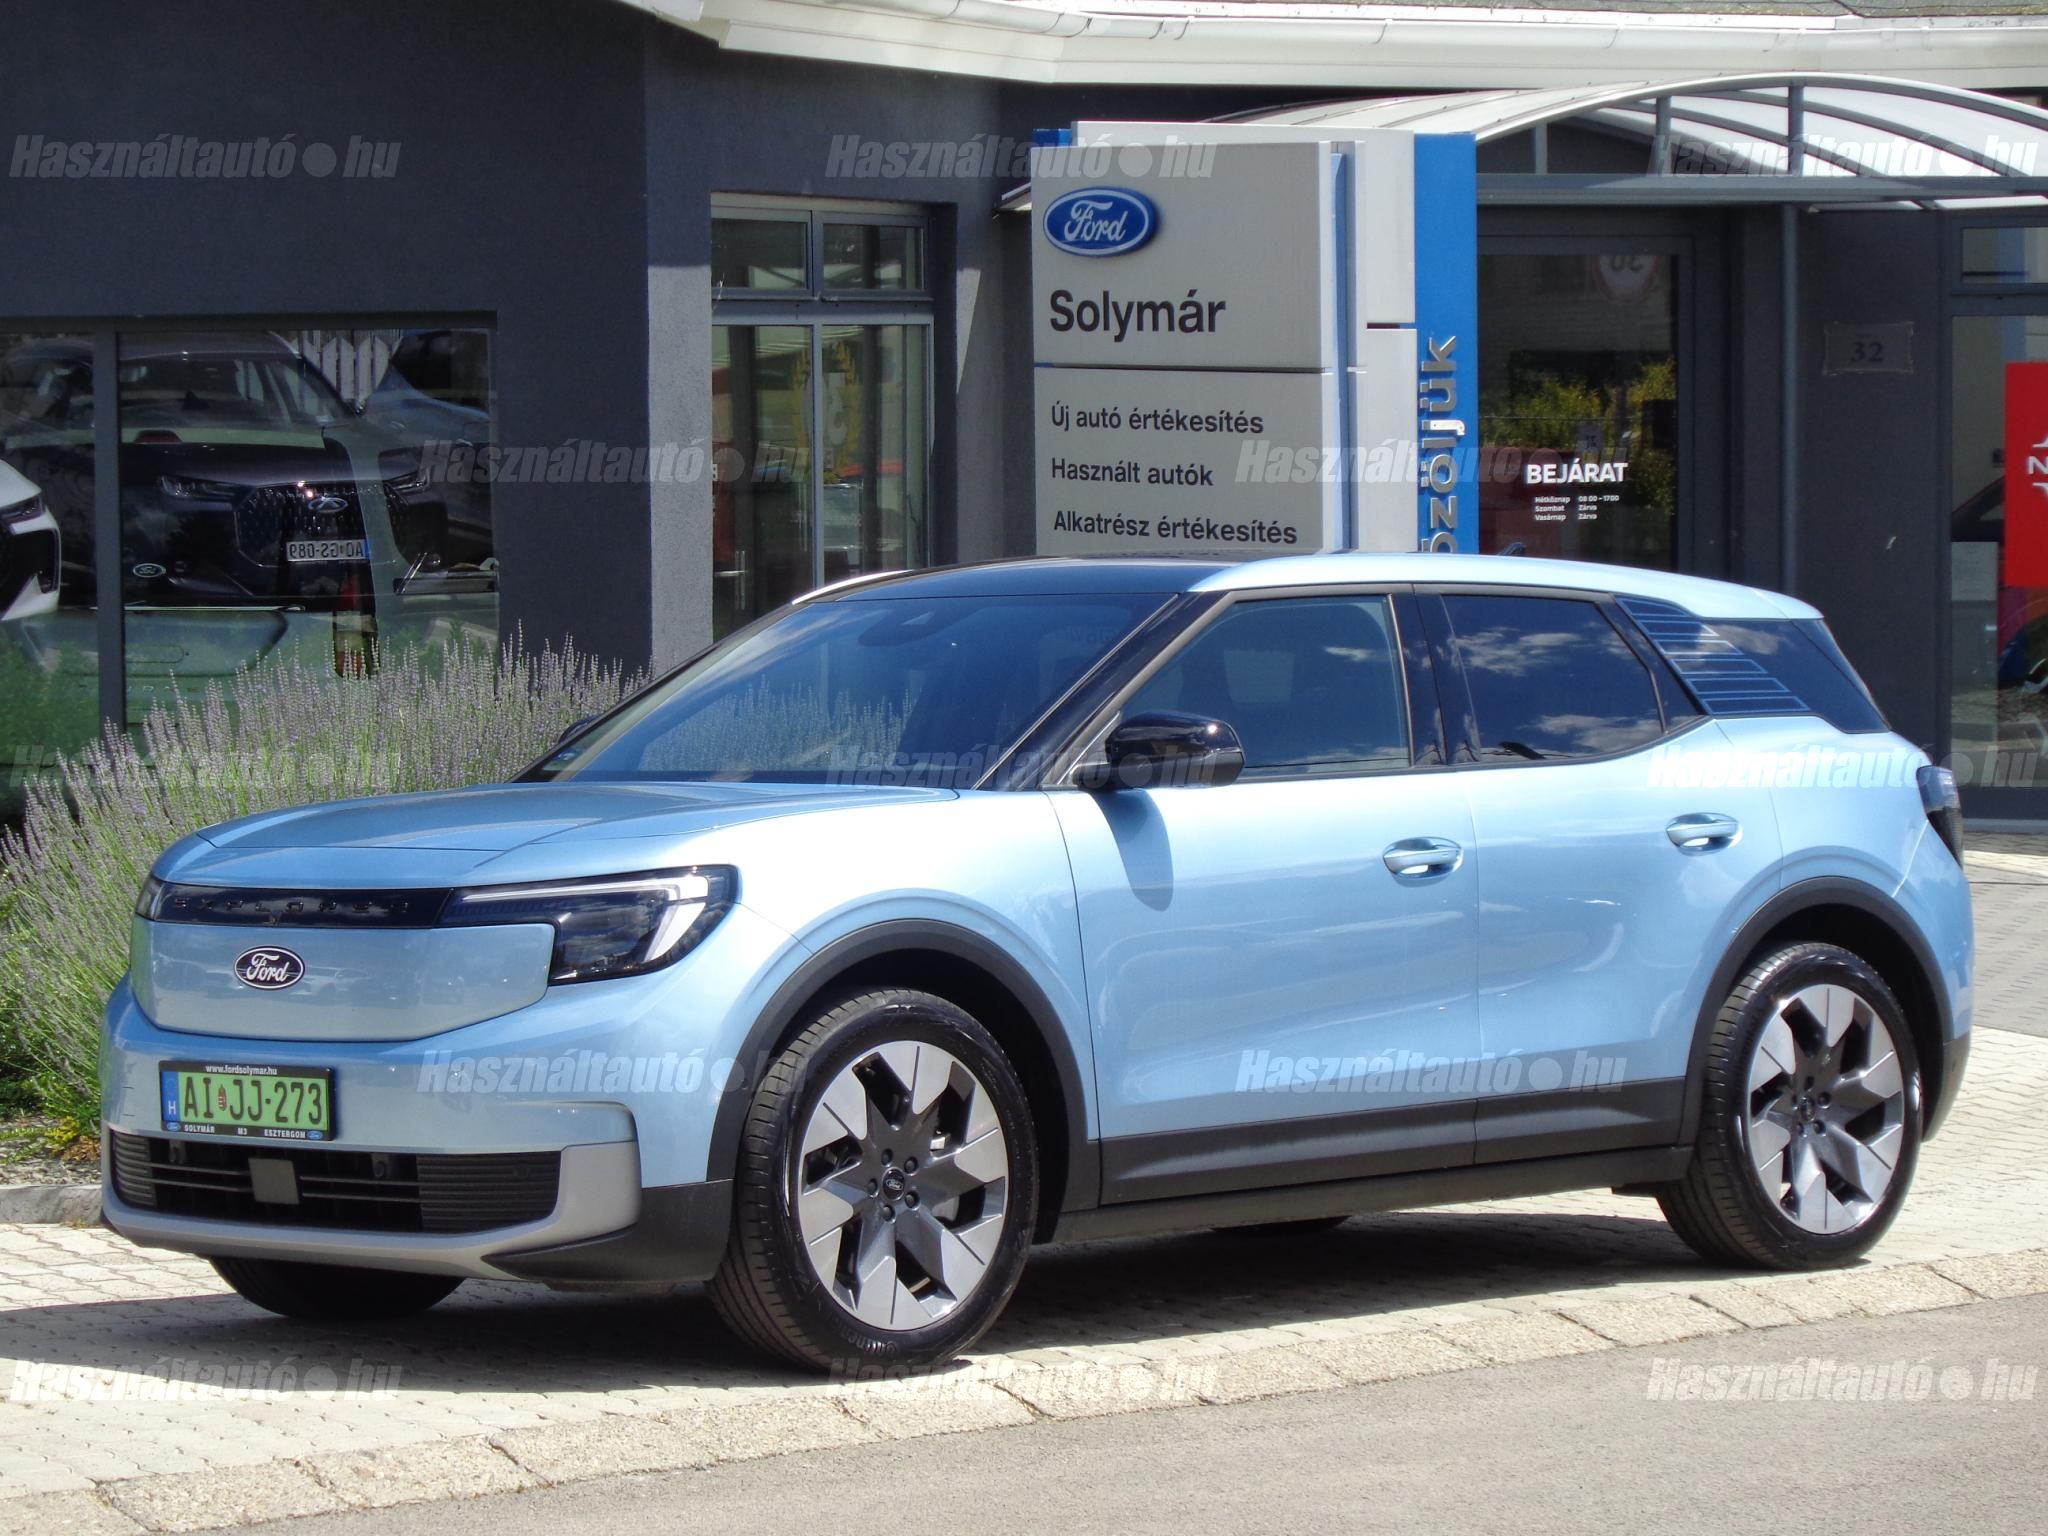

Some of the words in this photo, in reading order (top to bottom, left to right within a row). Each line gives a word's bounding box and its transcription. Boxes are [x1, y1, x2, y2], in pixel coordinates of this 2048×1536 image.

[1062, 199, 1127, 242] Ford
[1050, 288, 1226, 343] Solymár
[1851, 341, 1883, 362] 32
[1051, 400, 1069, 431] Új
[1076, 407, 1121, 429] autó
[1129, 407, 1264, 433] értékesítés
[1051, 457, 1140, 483] Használt
[1147, 464, 1213, 486] autók
[1526, 458, 1629, 485] BEJÁRAT
[1054, 510, 1150, 537] Alkatrész
[1157, 514, 1298, 544] értékesítés
[1535, 514, 1567, 522] Vasárnap
[245, 952, 290, 983] Ford
[205, 1064, 278, 1076] www.fordsolymar.hu
[168, 1101, 177, 1115] H
[184, 1076, 214, 1119] AI
[184, 1124, 215, 1133] SOLYMÁR
[237, 1127, 248, 1135] M3
[264, 1128, 306, 1139] ESZTERGOM
